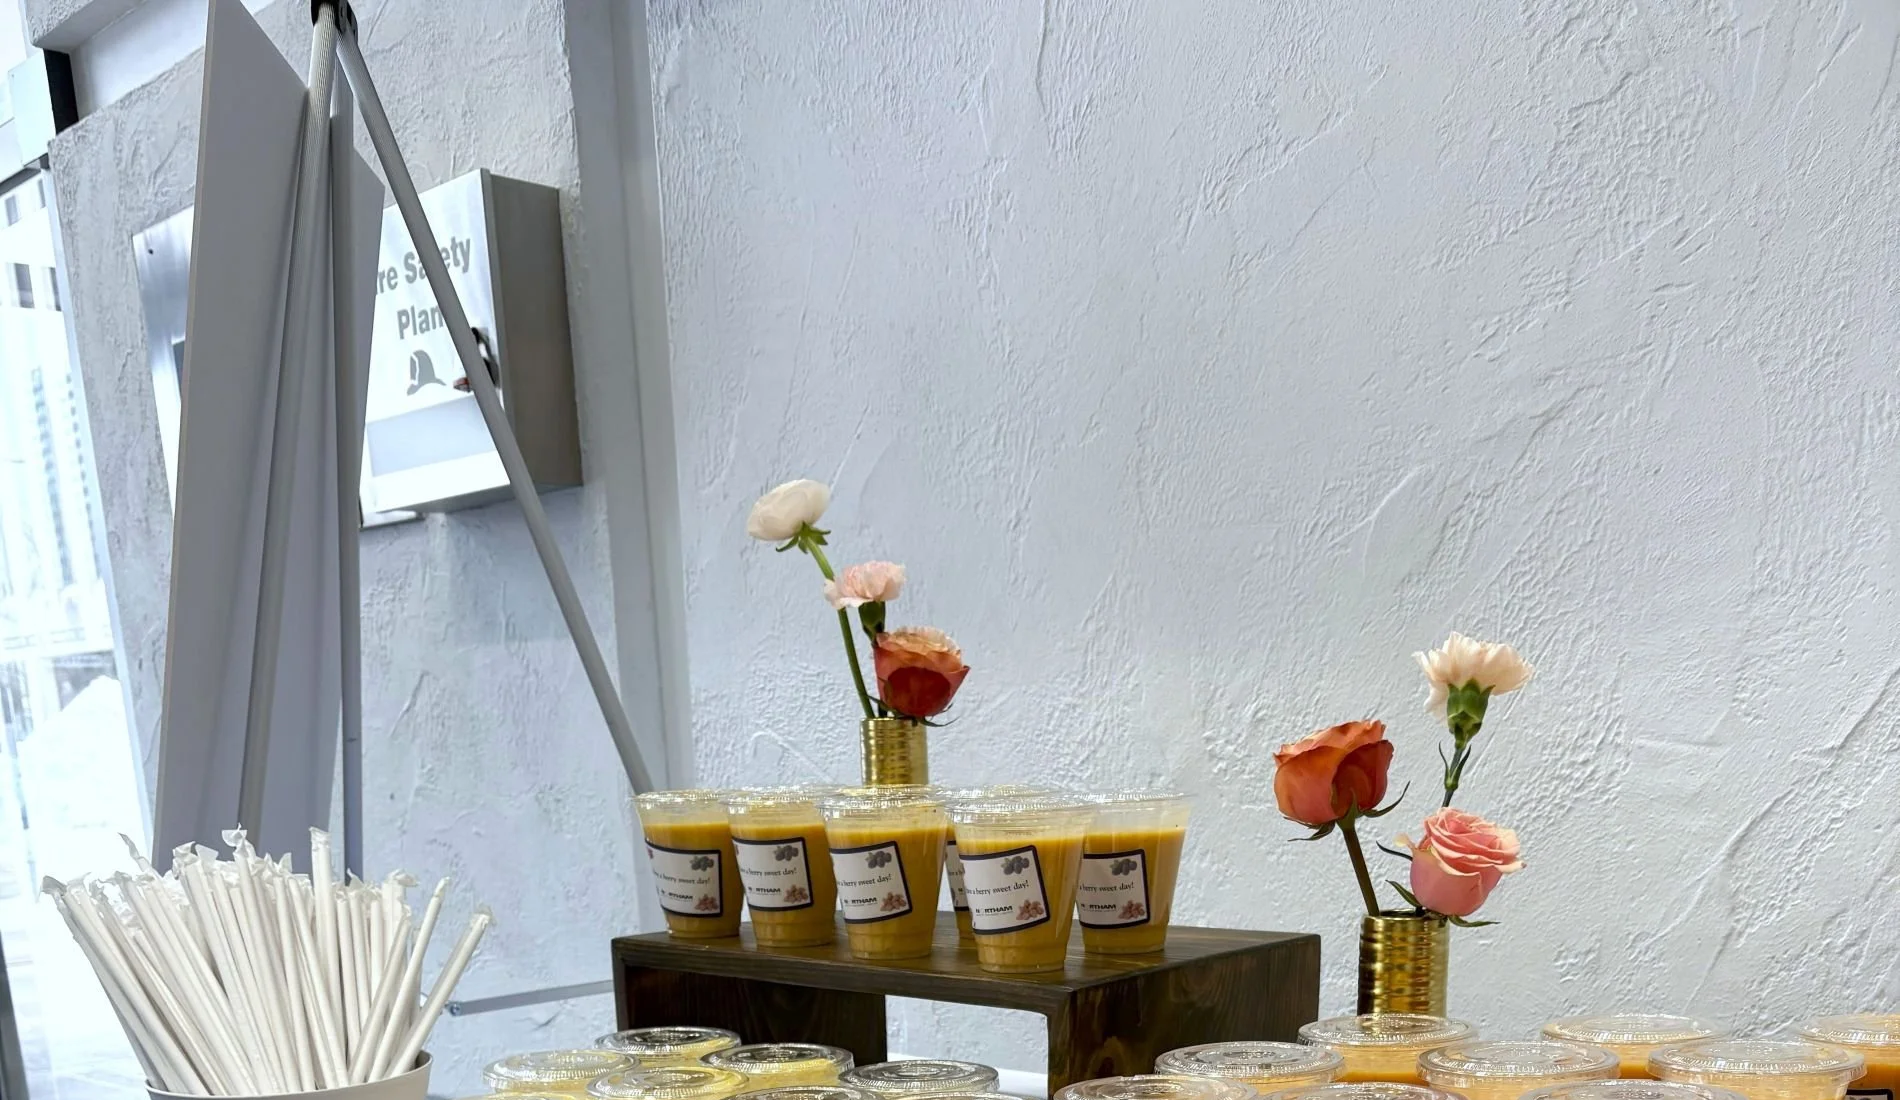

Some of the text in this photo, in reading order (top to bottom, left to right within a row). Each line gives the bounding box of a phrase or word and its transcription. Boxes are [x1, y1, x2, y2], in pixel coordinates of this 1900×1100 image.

[376, 236, 471, 295] re Sety
[396, 304, 444, 340] Plan
[1013, 879, 1030, 892] day!
[975, 905, 1013, 914] NRTHAM
